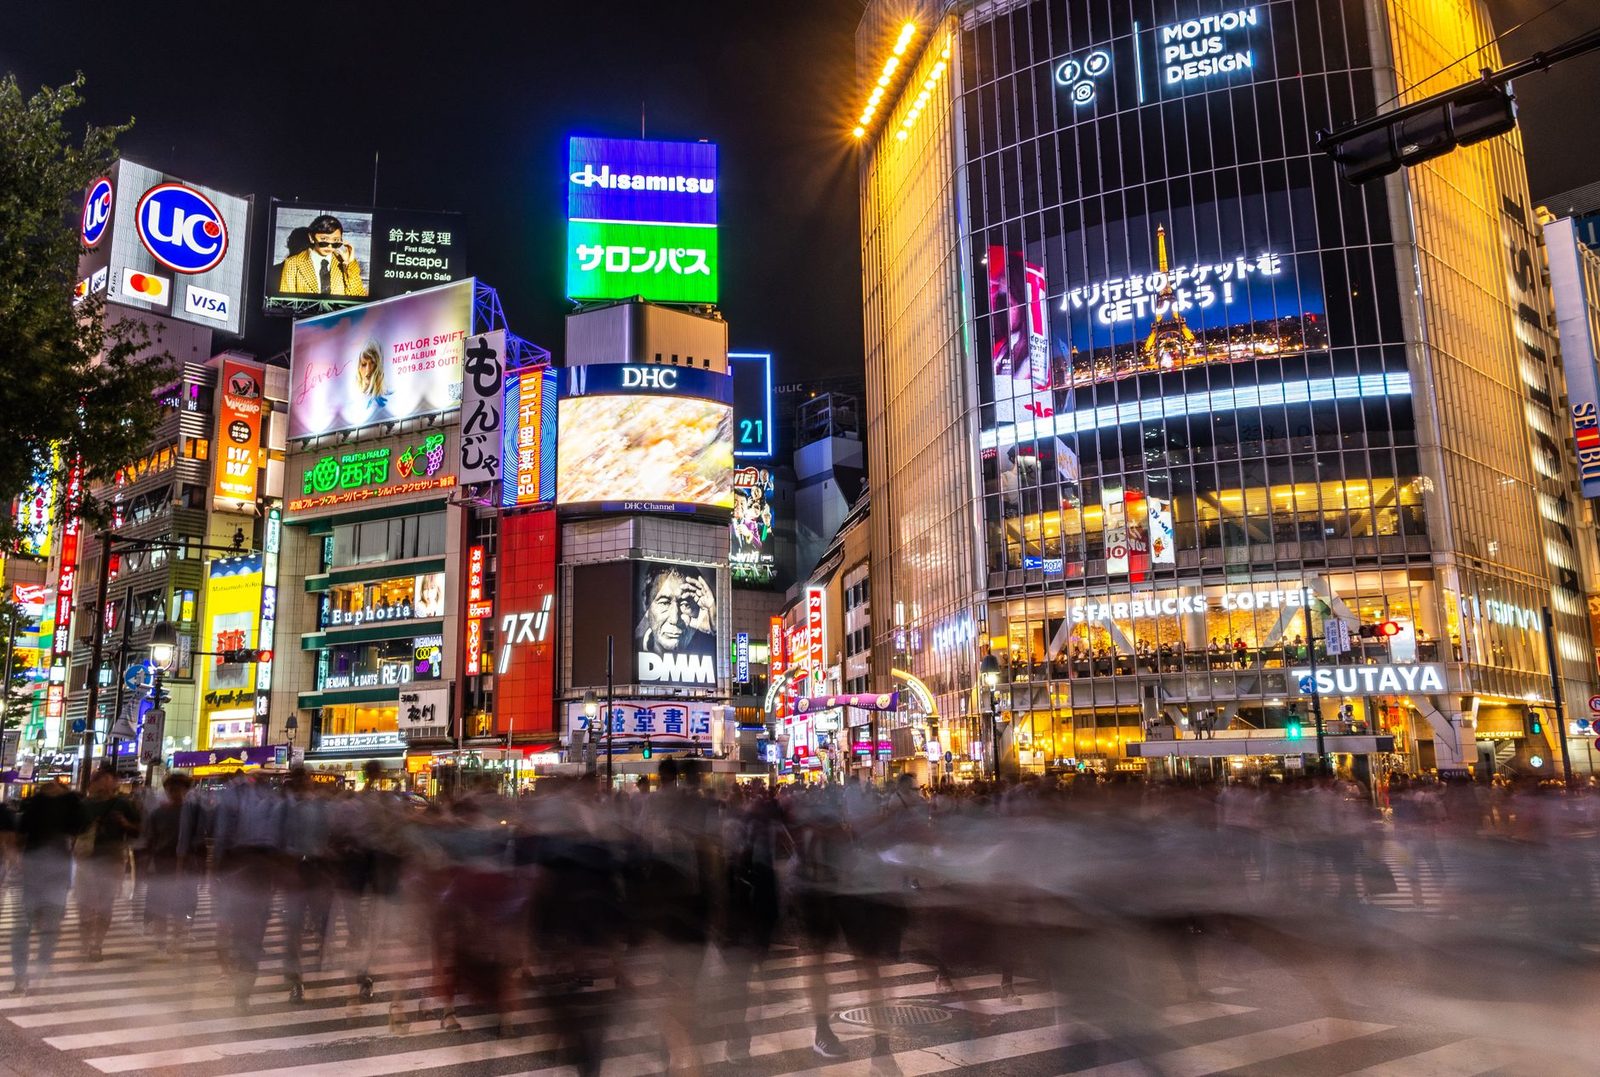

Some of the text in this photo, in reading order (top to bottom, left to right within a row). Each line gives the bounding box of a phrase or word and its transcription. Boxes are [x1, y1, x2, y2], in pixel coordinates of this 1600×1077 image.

[1163, 8, 1257, 44] MOTION
[1165, 37, 1223, 64] PLUS
[1167, 52, 1252, 84] DESIGN
[570, 164, 714, 194] Hisamitsu
[389, 228, 451, 246] 鈴木愛理
[404, 245, 437, 255] First Single
[576, 244, 710, 276] サロンパス
[384, 269, 452, 282] 2019.9.4 On Sale
[1060, 253, 1280, 312] パリ行きのチケットを
[191, 294, 227, 314] VISA
[393, 330, 465, 354] TAYLOR SWIFT
[392, 355, 409, 365] NEW
[410, 349, 437, 361] ALBUM
[397, 355, 459, 375] 2019.8.23 OUT!
[297, 359, 352, 405] Lover
[622, 367, 677, 389] DHC
[461, 336, 503, 478] もんじゃ
[518, 376, 537, 496] 三千里薬品
[740, 419, 763, 444] 21
[1572, 401, 1600, 482] SEIBU
[340, 459, 389, 488] 西村
[624, 501, 675, 511] DHC Channel
[331, 605, 411, 625] Euphoria
[1072, 587, 1315, 622] STARBUCKS COFFEE
[499, 593, 552, 674] クスリ
[638, 651, 715, 684] DMM
[1291, 665, 1443, 694] TSUTAYA
